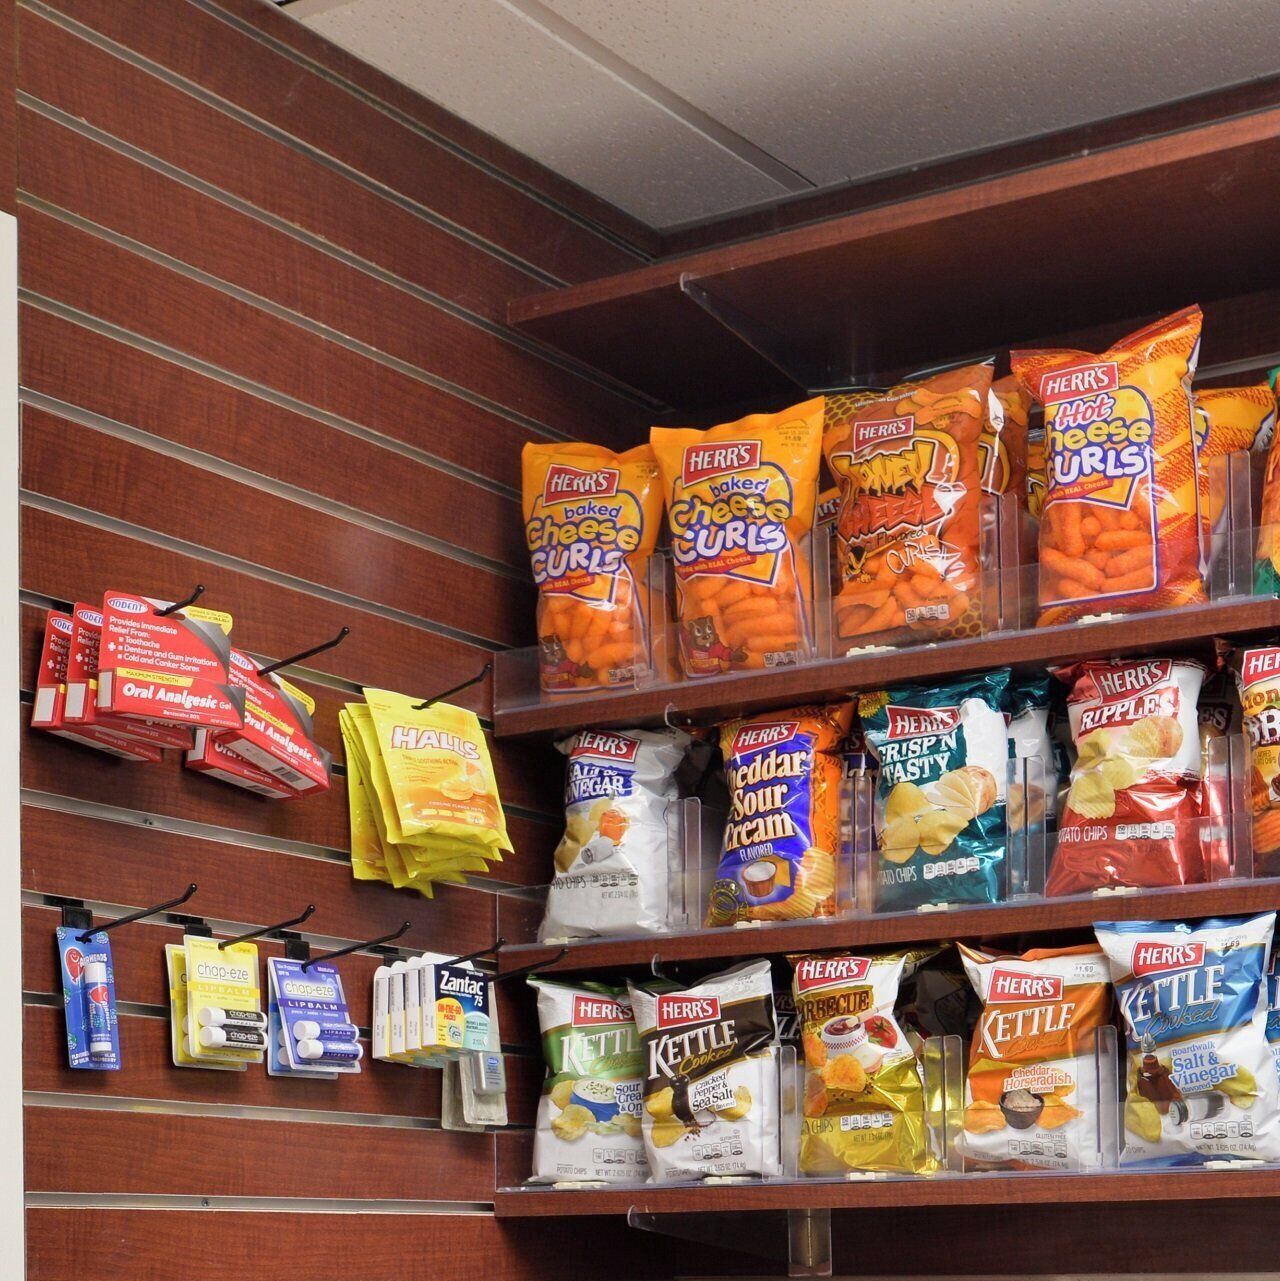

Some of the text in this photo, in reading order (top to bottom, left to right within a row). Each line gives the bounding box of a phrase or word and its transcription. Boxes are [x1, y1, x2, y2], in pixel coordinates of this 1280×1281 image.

[1047, 367, 1109, 395] HERR'S
[1056, 394, 1113, 429] Hot
[689, 446, 752, 471] HERR'S
[551, 472, 609, 492] HERR'S
[710, 477, 769, 497] baked
[564, 502, 622, 520] baked
[670, 494, 790, 531] Cheese
[527, 517, 639, 551] Cheese
[674, 522, 786, 562] CURLS
[531, 543, 623, 583] CURLS
[109, 625, 151, 638] Relief From:
[110, 616, 177, 635] Provides Immediate
[125, 636, 160, 649] Toothache
[124, 645, 217, 666] Denture and Gum Irritations
[124, 654, 200, 672] Cold and Canker Sores
[1100, 661, 1164, 694] HERR'S
[123, 683, 232, 711] Oral Analgesic Gel
[895, 711, 960, 735] HERR'S
[1080, 693, 1177, 733] RIPPLES
[392, 725, 481, 760] HALLS
[736, 723, 791, 748] HERR'S
[882, 751, 951, 785] TASTY
[732, 785, 789, 821] Sour
[739, 843, 774, 857] FLAVORED
[1137, 944, 1197, 966] HERR'S
[197, 962, 248, 980] chap-eze
[801, 959, 861, 980] HERR'S
[285, 982, 334, 996] chap-eze
[440, 971, 484, 995] Zantac
[997, 977, 1054, 997] HERR'S
[288, 1001, 338, 1010] LIPBALM
[474, 996, 483, 1007] 75
[662, 999, 714, 1019] HERR'S
[979, 1002, 1075, 1059] KETTLE
[648, 1020, 738, 1081] KETTLE
[679, 1045, 735, 1074] Cooked
[1004, 1073, 1072, 1092] Horseradish
[1013, 1067, 1050, 1079] Cheddar
[1170, 1062, 1238, 1090] Vinegar
[615, 1083, 640, 1094] Sour
[692, 1088, 733, 1111] Sea Salt
